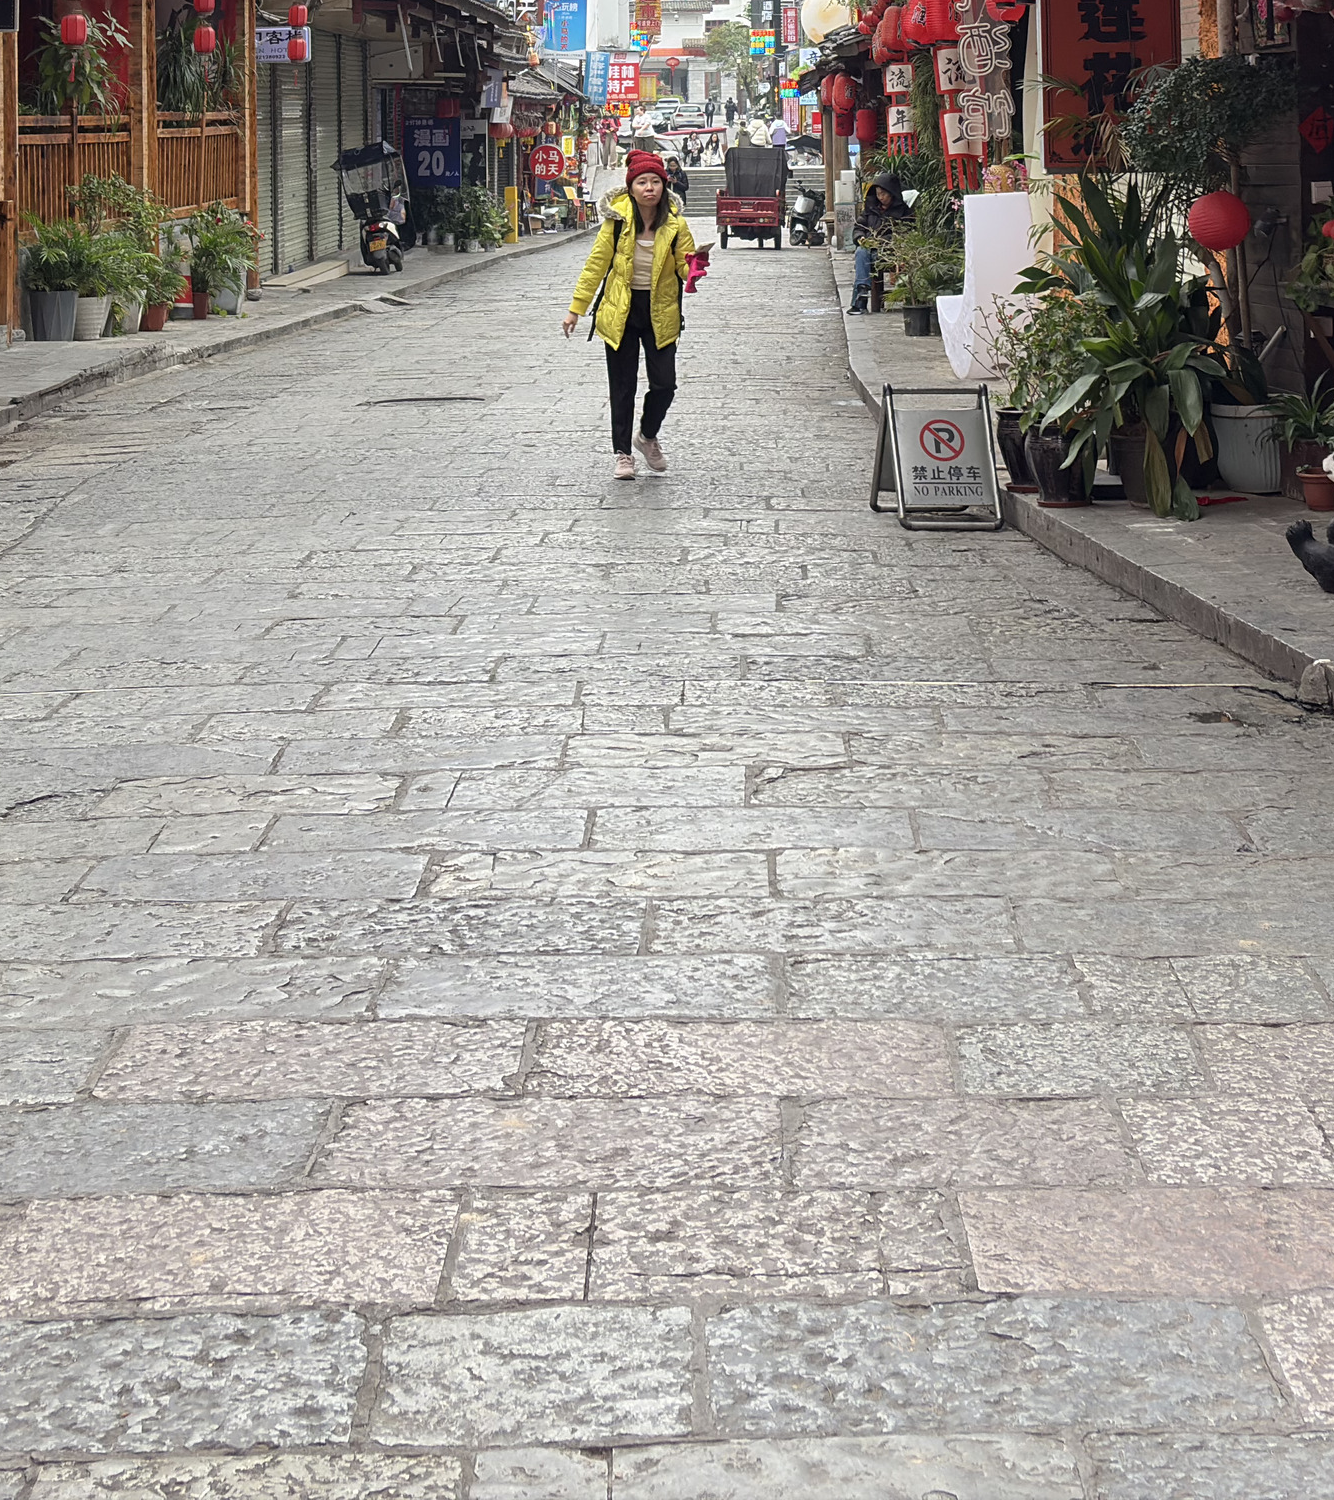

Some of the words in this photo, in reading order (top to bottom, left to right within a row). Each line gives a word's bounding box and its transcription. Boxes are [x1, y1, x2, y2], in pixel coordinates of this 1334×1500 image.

[413, 128, 450, 147] 漫画
[535, 150, 559, 162] 小马
[418, 151, 445, 177] 20
[534, 163, 559, 176] 的天
[912, 465, 982, 481] 禁止停车
[913, 485, 929, 496] NO
[934, 485, 984, 496] PARKING
